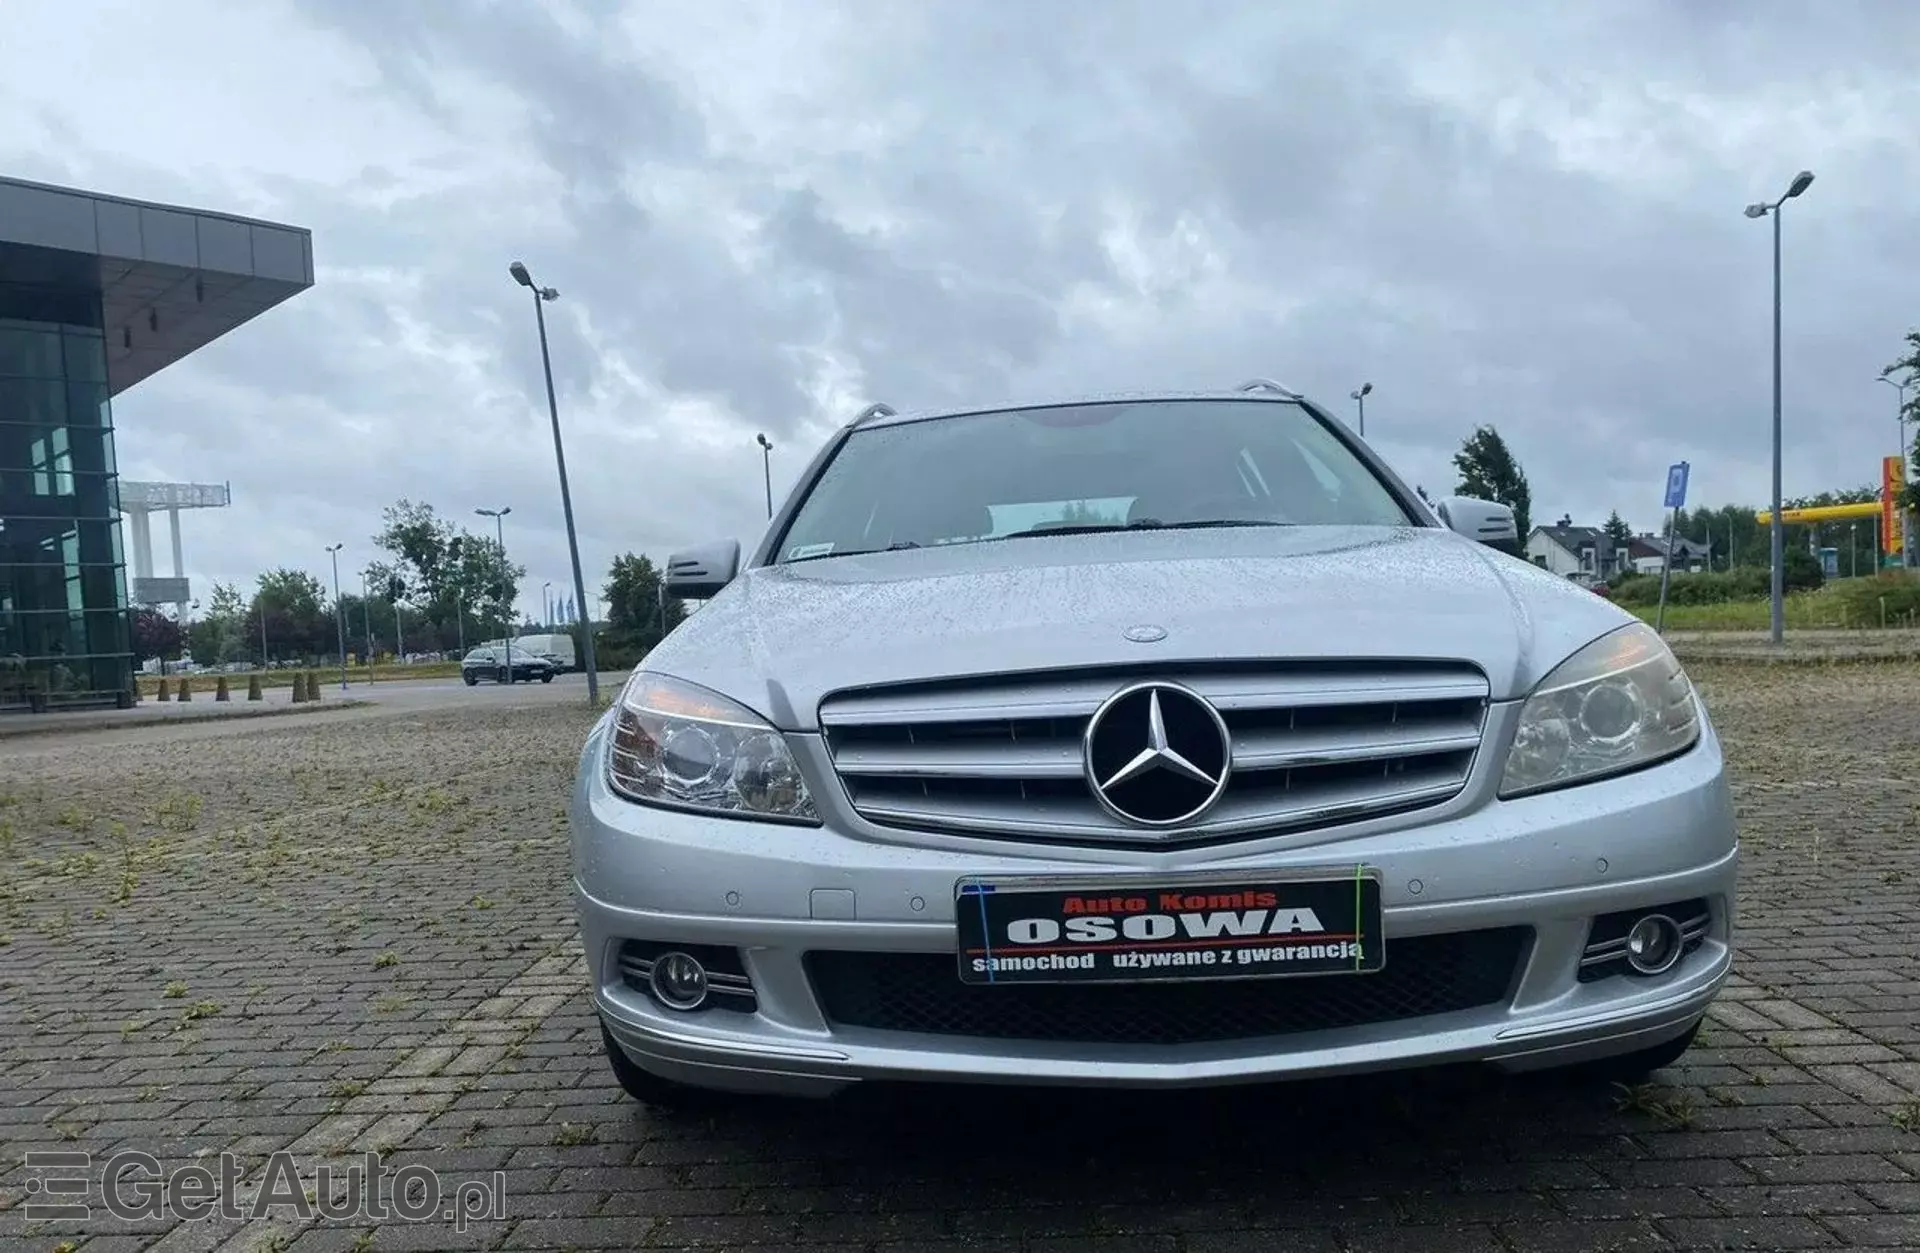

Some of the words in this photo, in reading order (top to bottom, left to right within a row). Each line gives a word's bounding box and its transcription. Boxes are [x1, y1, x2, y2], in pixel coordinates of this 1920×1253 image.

[1063, 897, 1148, 914] Auto
[1159, 890, 1278, 911] Komis
[1007, 907, 1325, 944] OSOWA
[972, 953, 1095, 972] samochod
[1113, 949, 1216, 968] używane
[1221, 951, 1232, 964] z
[1237, 941, 1364, 965] gwarancją
